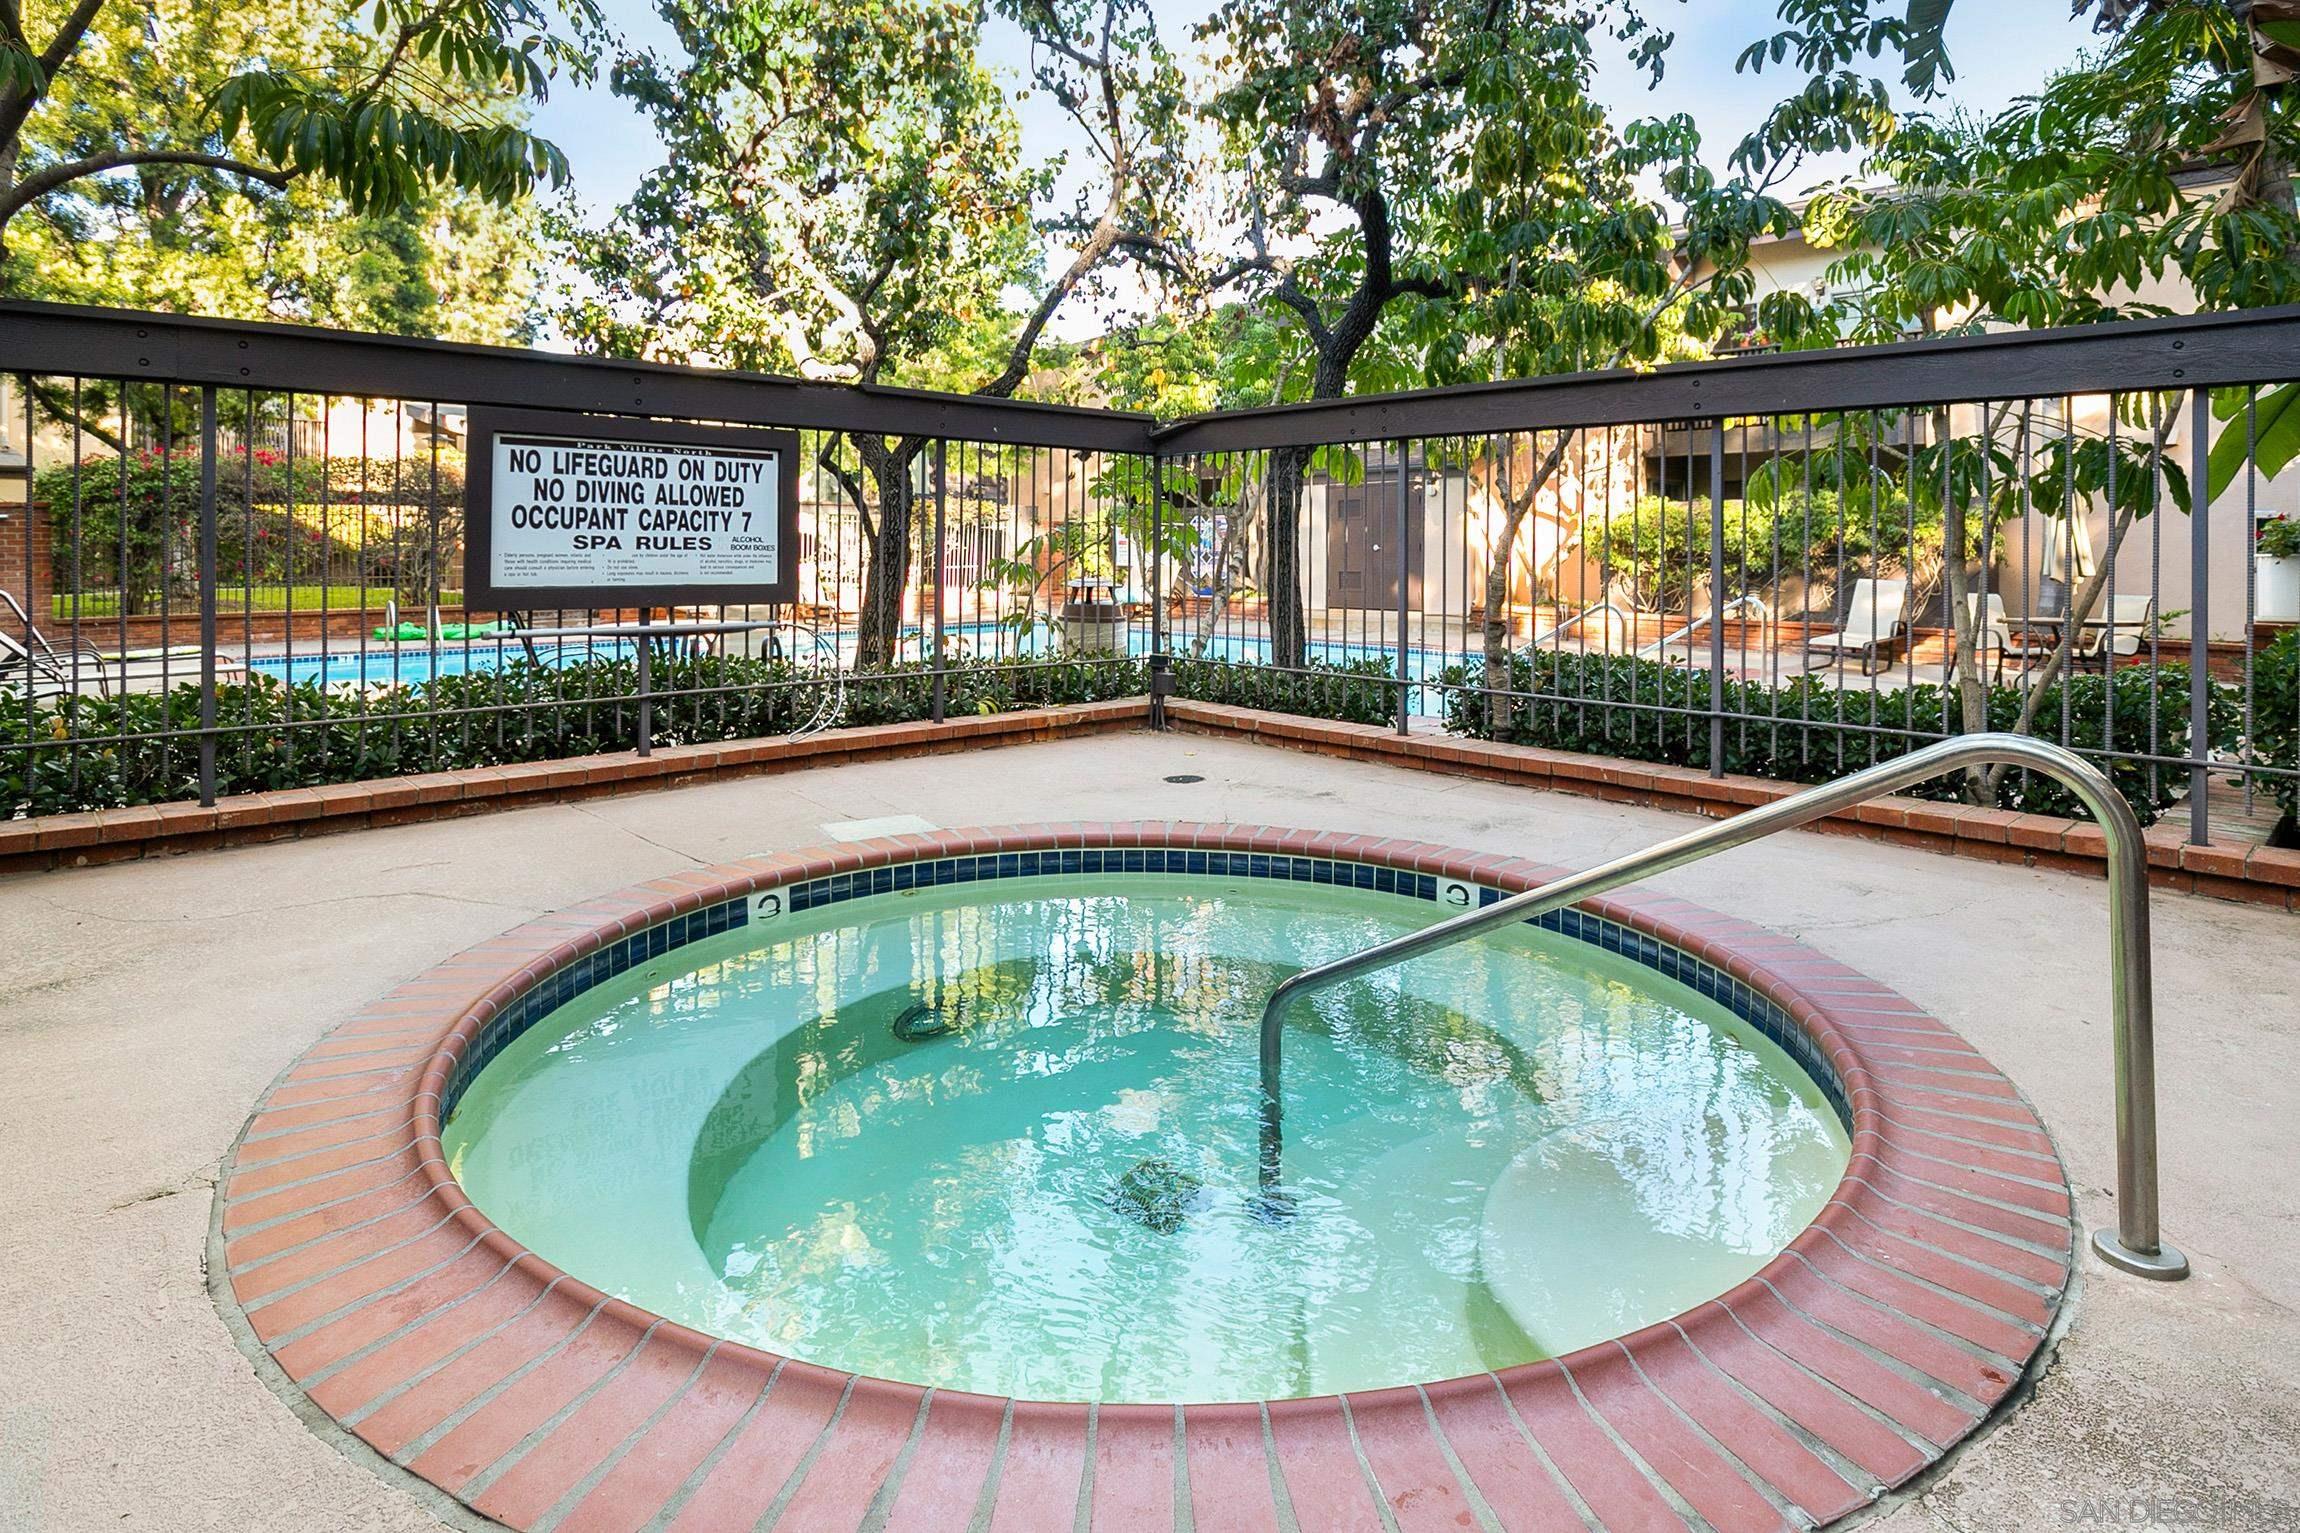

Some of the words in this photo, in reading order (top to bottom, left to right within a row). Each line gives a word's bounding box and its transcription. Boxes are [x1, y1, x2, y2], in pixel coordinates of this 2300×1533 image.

[577, 442, 611, 450] Park
[621, 445, 662, 453] Villas
[673, 448, 711, 456] North
[510, 449, 541, 473] NO
[553, 451, 669, 479] LIFEGUARD
[679, 459, 704, 481] ON
[715, 461, 763, 483] DUTY
[534, 478, 564, 502] NO
[576, 480, 644, 504] DIVING
[655, 484, 744, 507] ALLOWED
[512, 505, 628, 530] OCCUPANT
[639, 509, 732, 532] CAPACITY
[742, 512, 751, 532] 7
[573, 535, 622, 549] SPA
[636, 536, 712, 550] RULES
[730, 543, 752, 551] BOOM
[752, 544, 776, 552] BOXES
